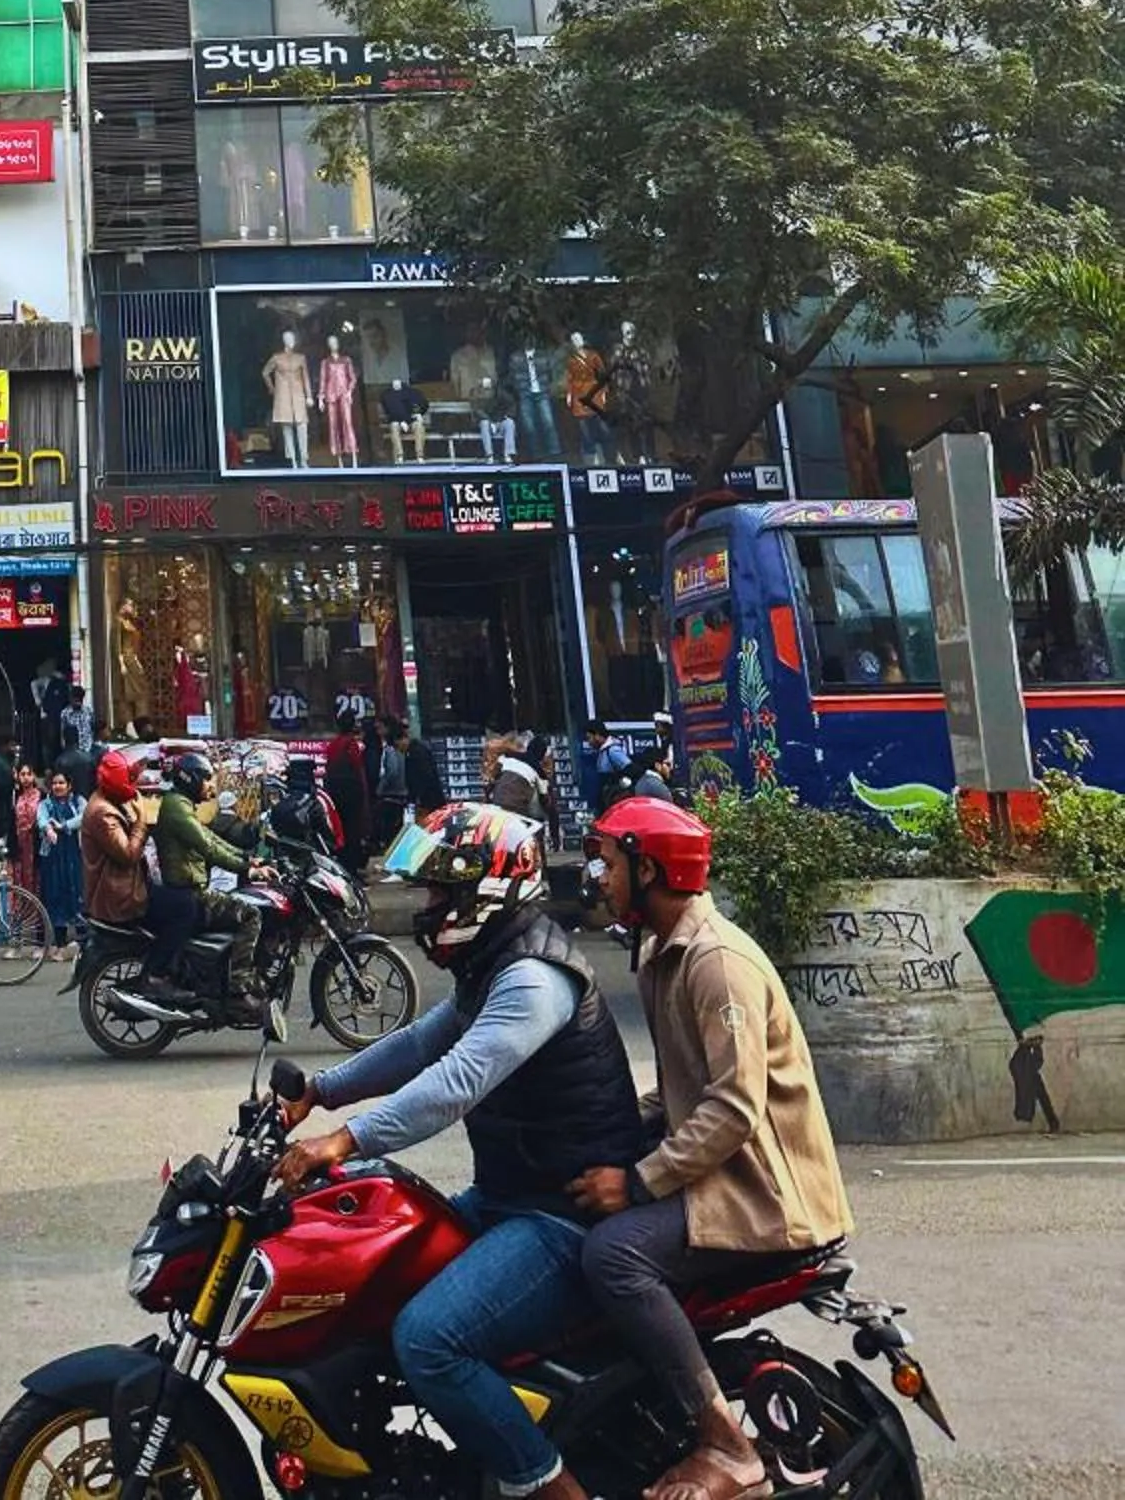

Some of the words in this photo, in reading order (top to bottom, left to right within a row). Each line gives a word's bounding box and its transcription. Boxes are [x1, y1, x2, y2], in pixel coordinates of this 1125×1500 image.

[202, 41, 348, 73] Stylish
[126, 365, 200, 381] NATION
[451, 483, 494, 504] T&C
[508, 481, 550, 502] T&C
[124, 494, 218, 531] PINK
[449, 506, 502, 523] LOUNGE
[134, 1414, 172, 1477] YAMAHA
